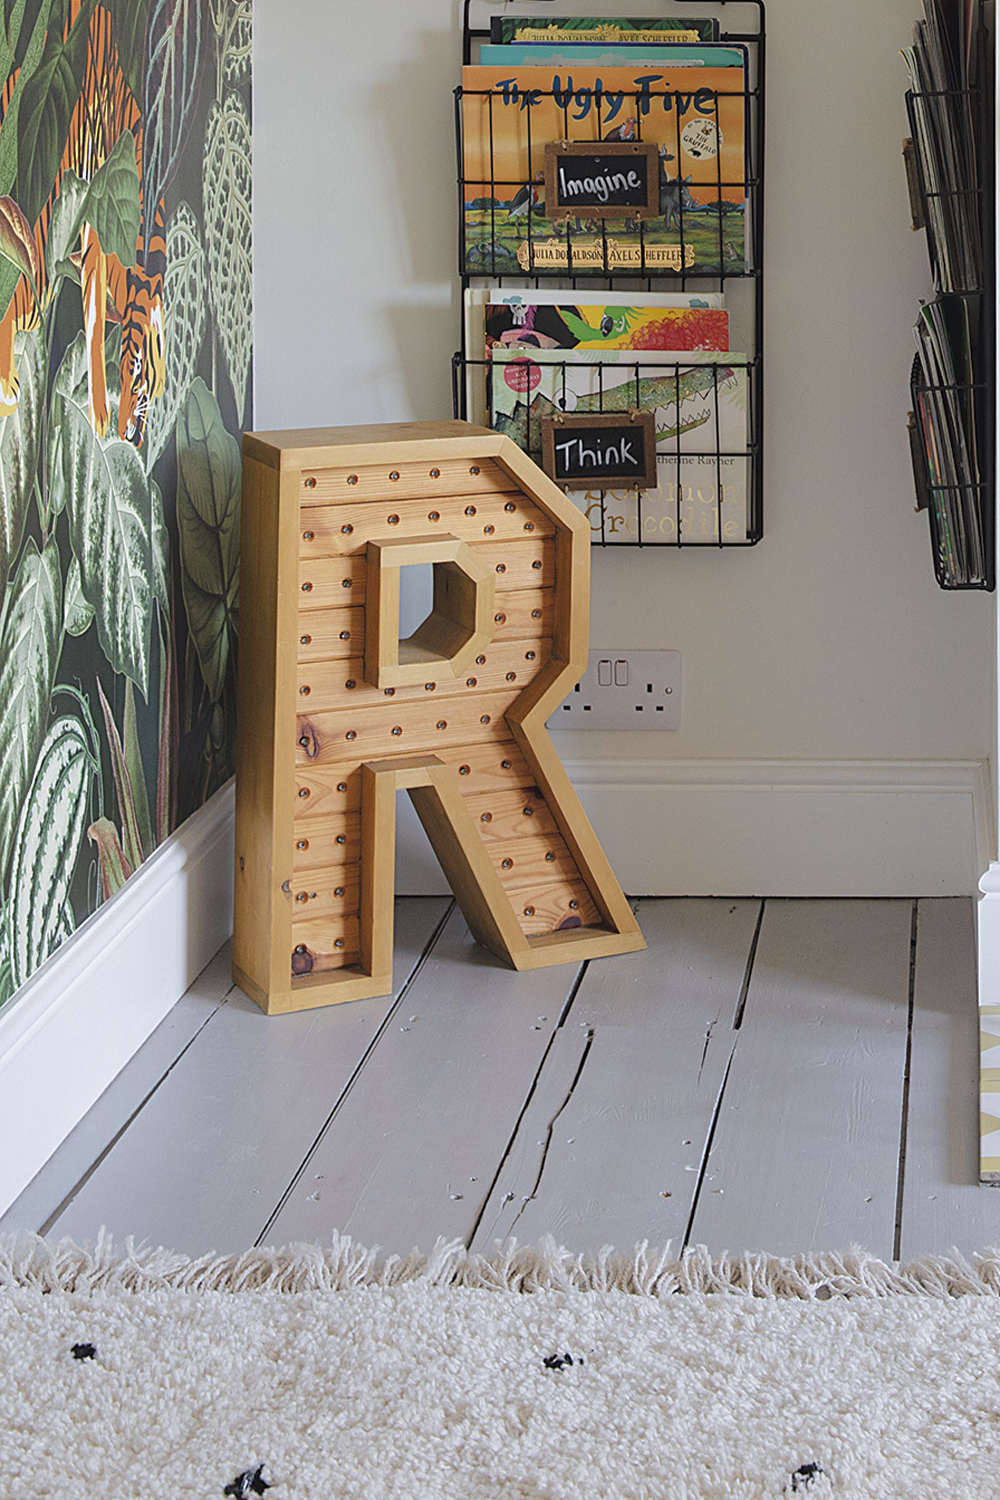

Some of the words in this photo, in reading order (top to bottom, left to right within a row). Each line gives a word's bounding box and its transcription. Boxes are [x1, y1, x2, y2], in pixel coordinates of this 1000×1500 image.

[495, 77, 543, 112] The
[552, 74, 625, 123] Ugly
[633, 74, 717, 116] Five
[559, 166, 641, 201] Imagine
[555, 249, 604, 260] DOALDSON
[634, 249, 682, 261] SHEFFLER
[555, 437, 638, 471] Think
[584, 503, 739, 536] Crocodile
